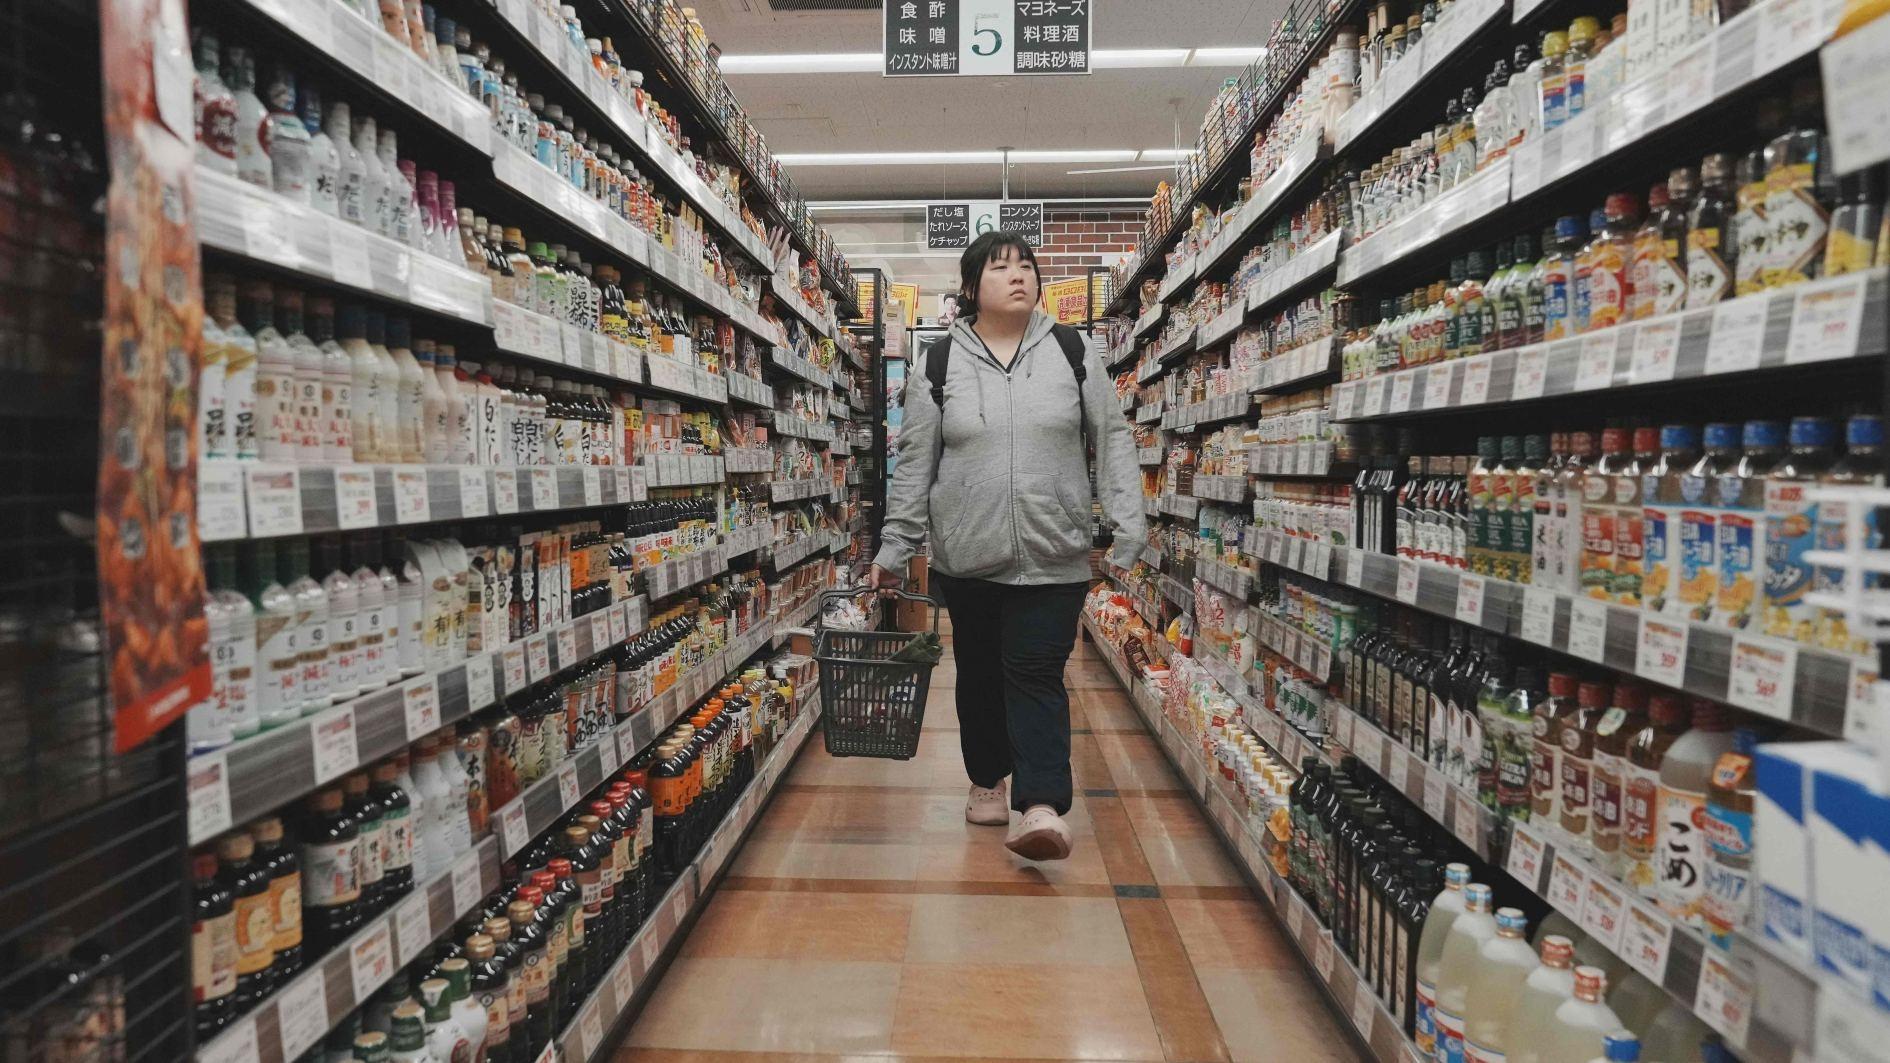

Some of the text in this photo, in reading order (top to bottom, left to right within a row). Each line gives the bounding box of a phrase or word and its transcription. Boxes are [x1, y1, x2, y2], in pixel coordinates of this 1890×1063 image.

[900, 1, 946, 19] 食酢
[1017, 0, 1085, 16] マヨネーズ
[900, 27, 946, 44] 味噌
[972, 13, 1002, 56] 5
[1024, 25, 1079, 43] 料理酒
[889, 51, 957, 70] インスタント味噌汁
[1017, 51, 1086, 69] 調味砂糖
[1001, 206, 1039, 217] コンソメ
[976, 214, 994, 236] 6
[1001, 220, 1040, 231] インスタントスープ
[930, 236, 968, 246] ケチャップ
